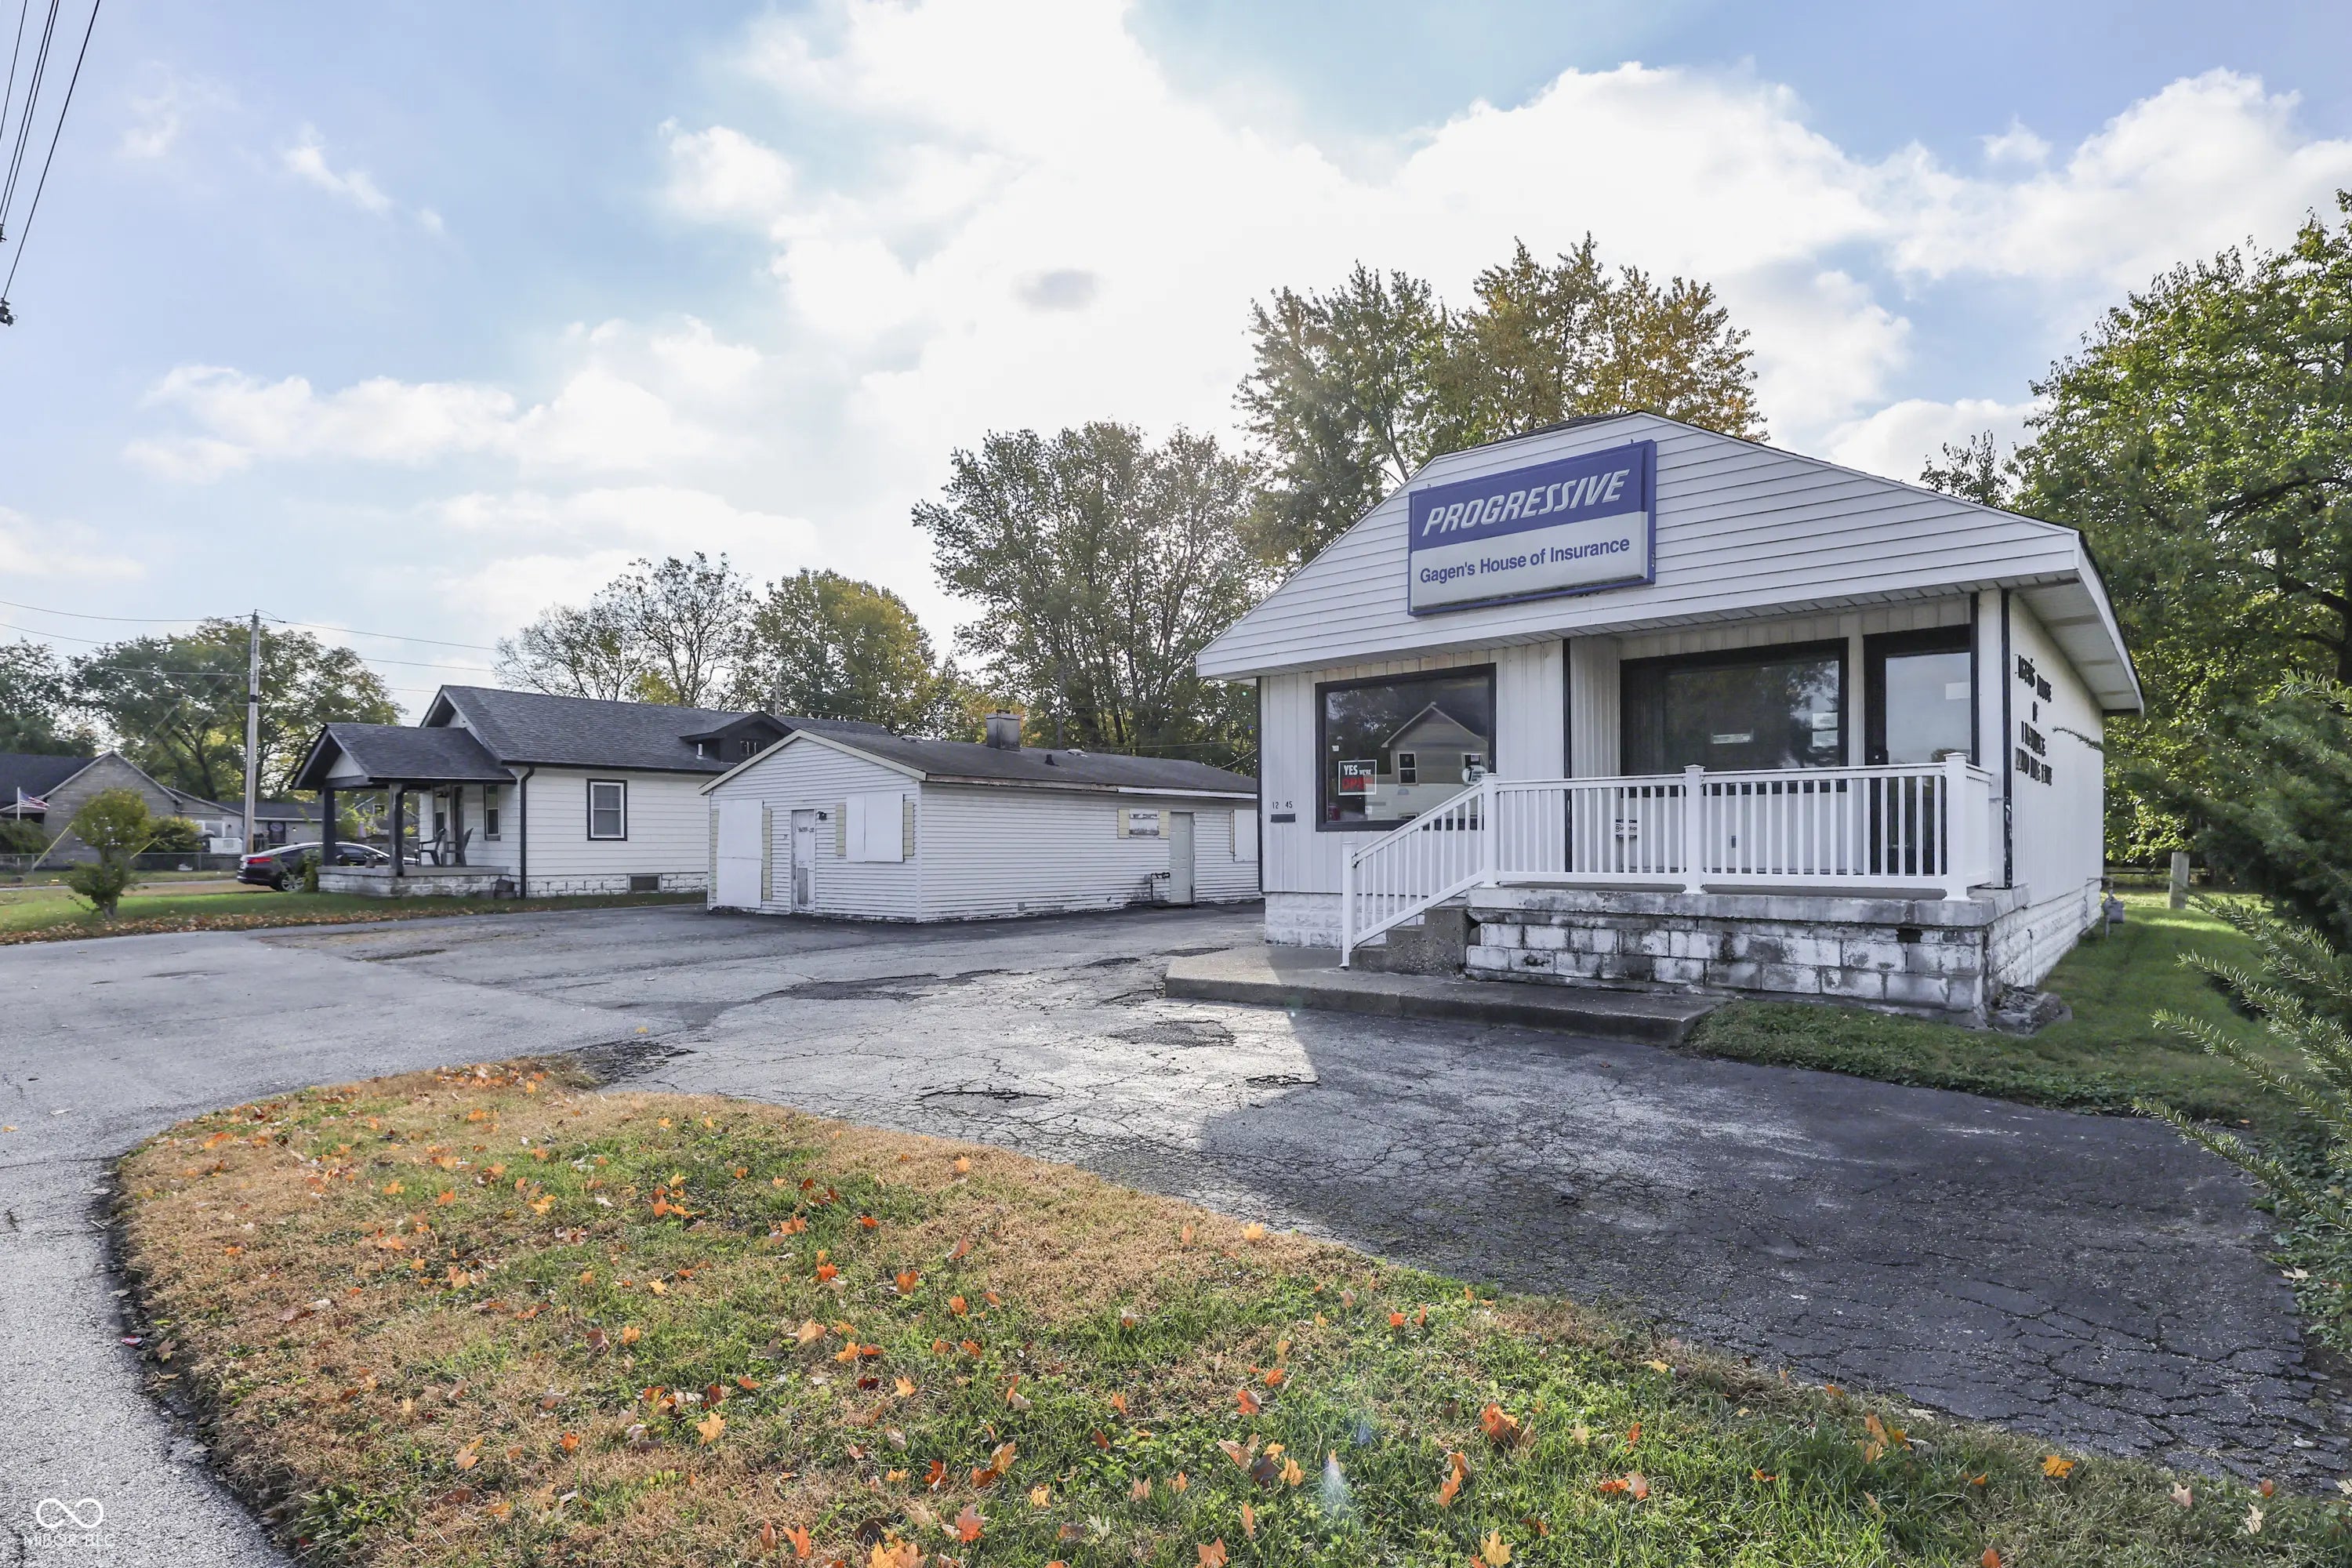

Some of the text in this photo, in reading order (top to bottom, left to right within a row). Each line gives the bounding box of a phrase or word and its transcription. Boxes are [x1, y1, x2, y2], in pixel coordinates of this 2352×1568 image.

[1422, 469, 1631, 537] PROGRESSIVE
[1420, 539, 1630, 584] Gagen's House of Insurance
[1343, 764, 1359, 775] YES
